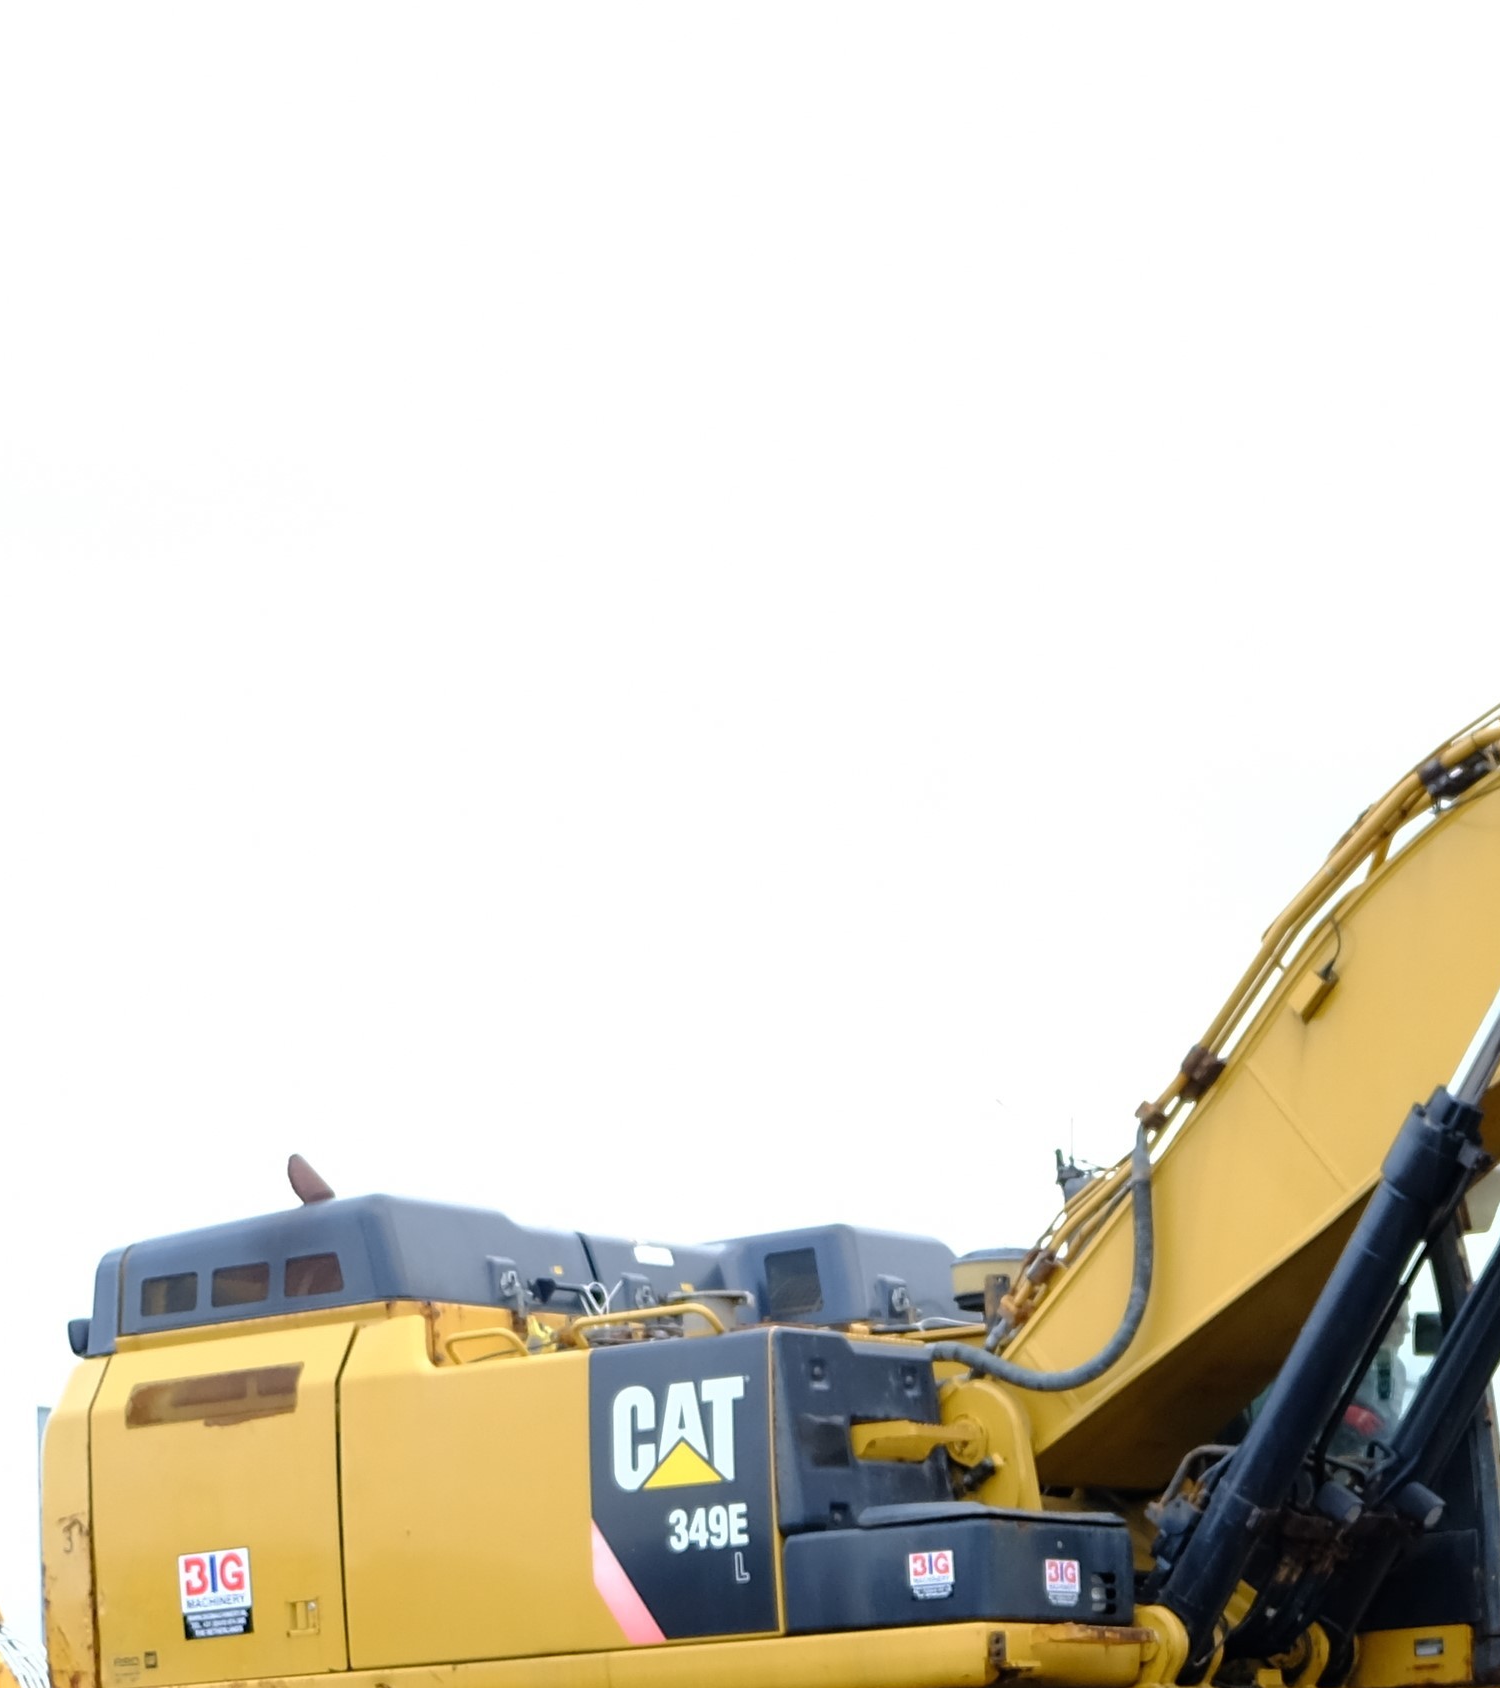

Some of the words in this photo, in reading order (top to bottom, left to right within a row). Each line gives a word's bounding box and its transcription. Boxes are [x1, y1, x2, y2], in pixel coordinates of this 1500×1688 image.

[612, 1375, 745, 1493] CAT
[668, 1502, 750, 1552] 349E
[734, 1551, 751, 1583] L
[186, 1594, 246, 1609] MACHINERY
